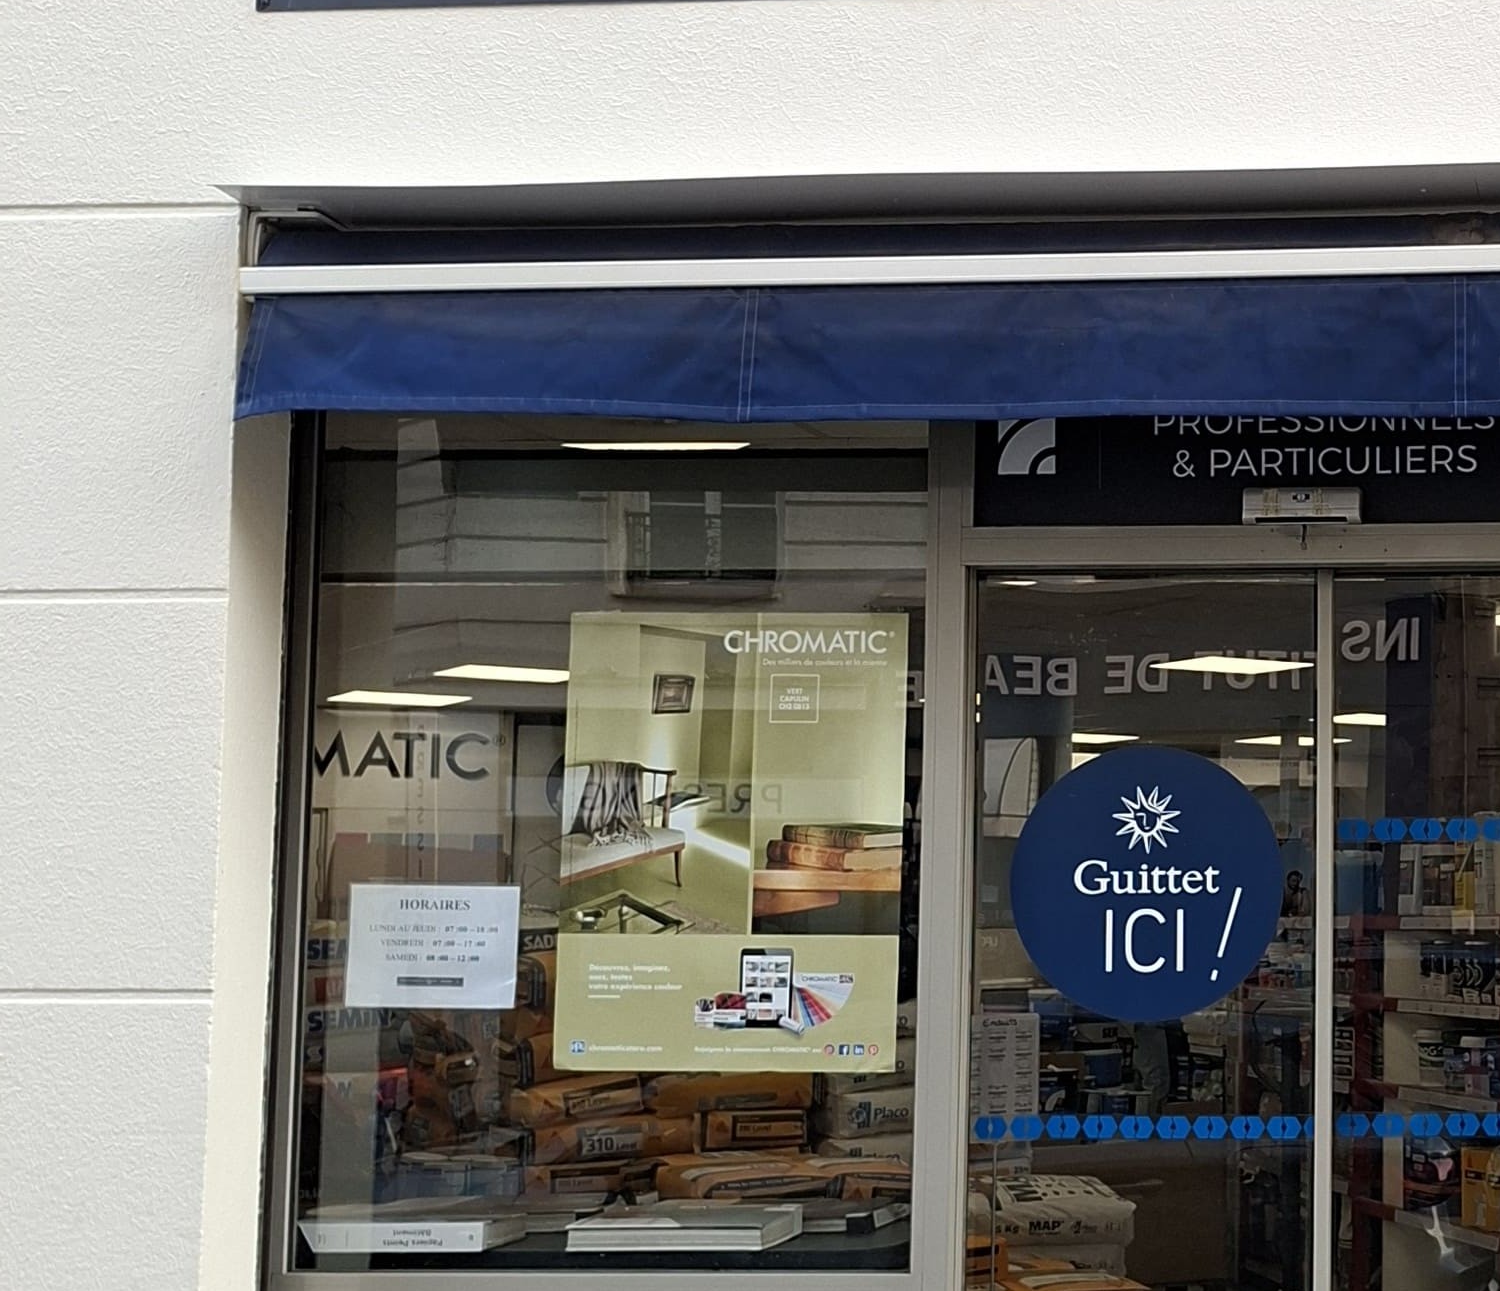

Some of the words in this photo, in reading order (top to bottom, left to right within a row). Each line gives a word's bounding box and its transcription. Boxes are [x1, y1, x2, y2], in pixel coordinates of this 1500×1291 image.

[1172, 450, 1196, 478] &
[1209, 444, 1478, 478] PARTICULIERS
[1073, 859, 1221, 896] Guittet
[400, 899, 472, 911] HORAIRES
[1104, 908, 1184, 974] ICI
[873, 1105, 909, 1120] Placo
[587, 1137, 614, 1153] 310
